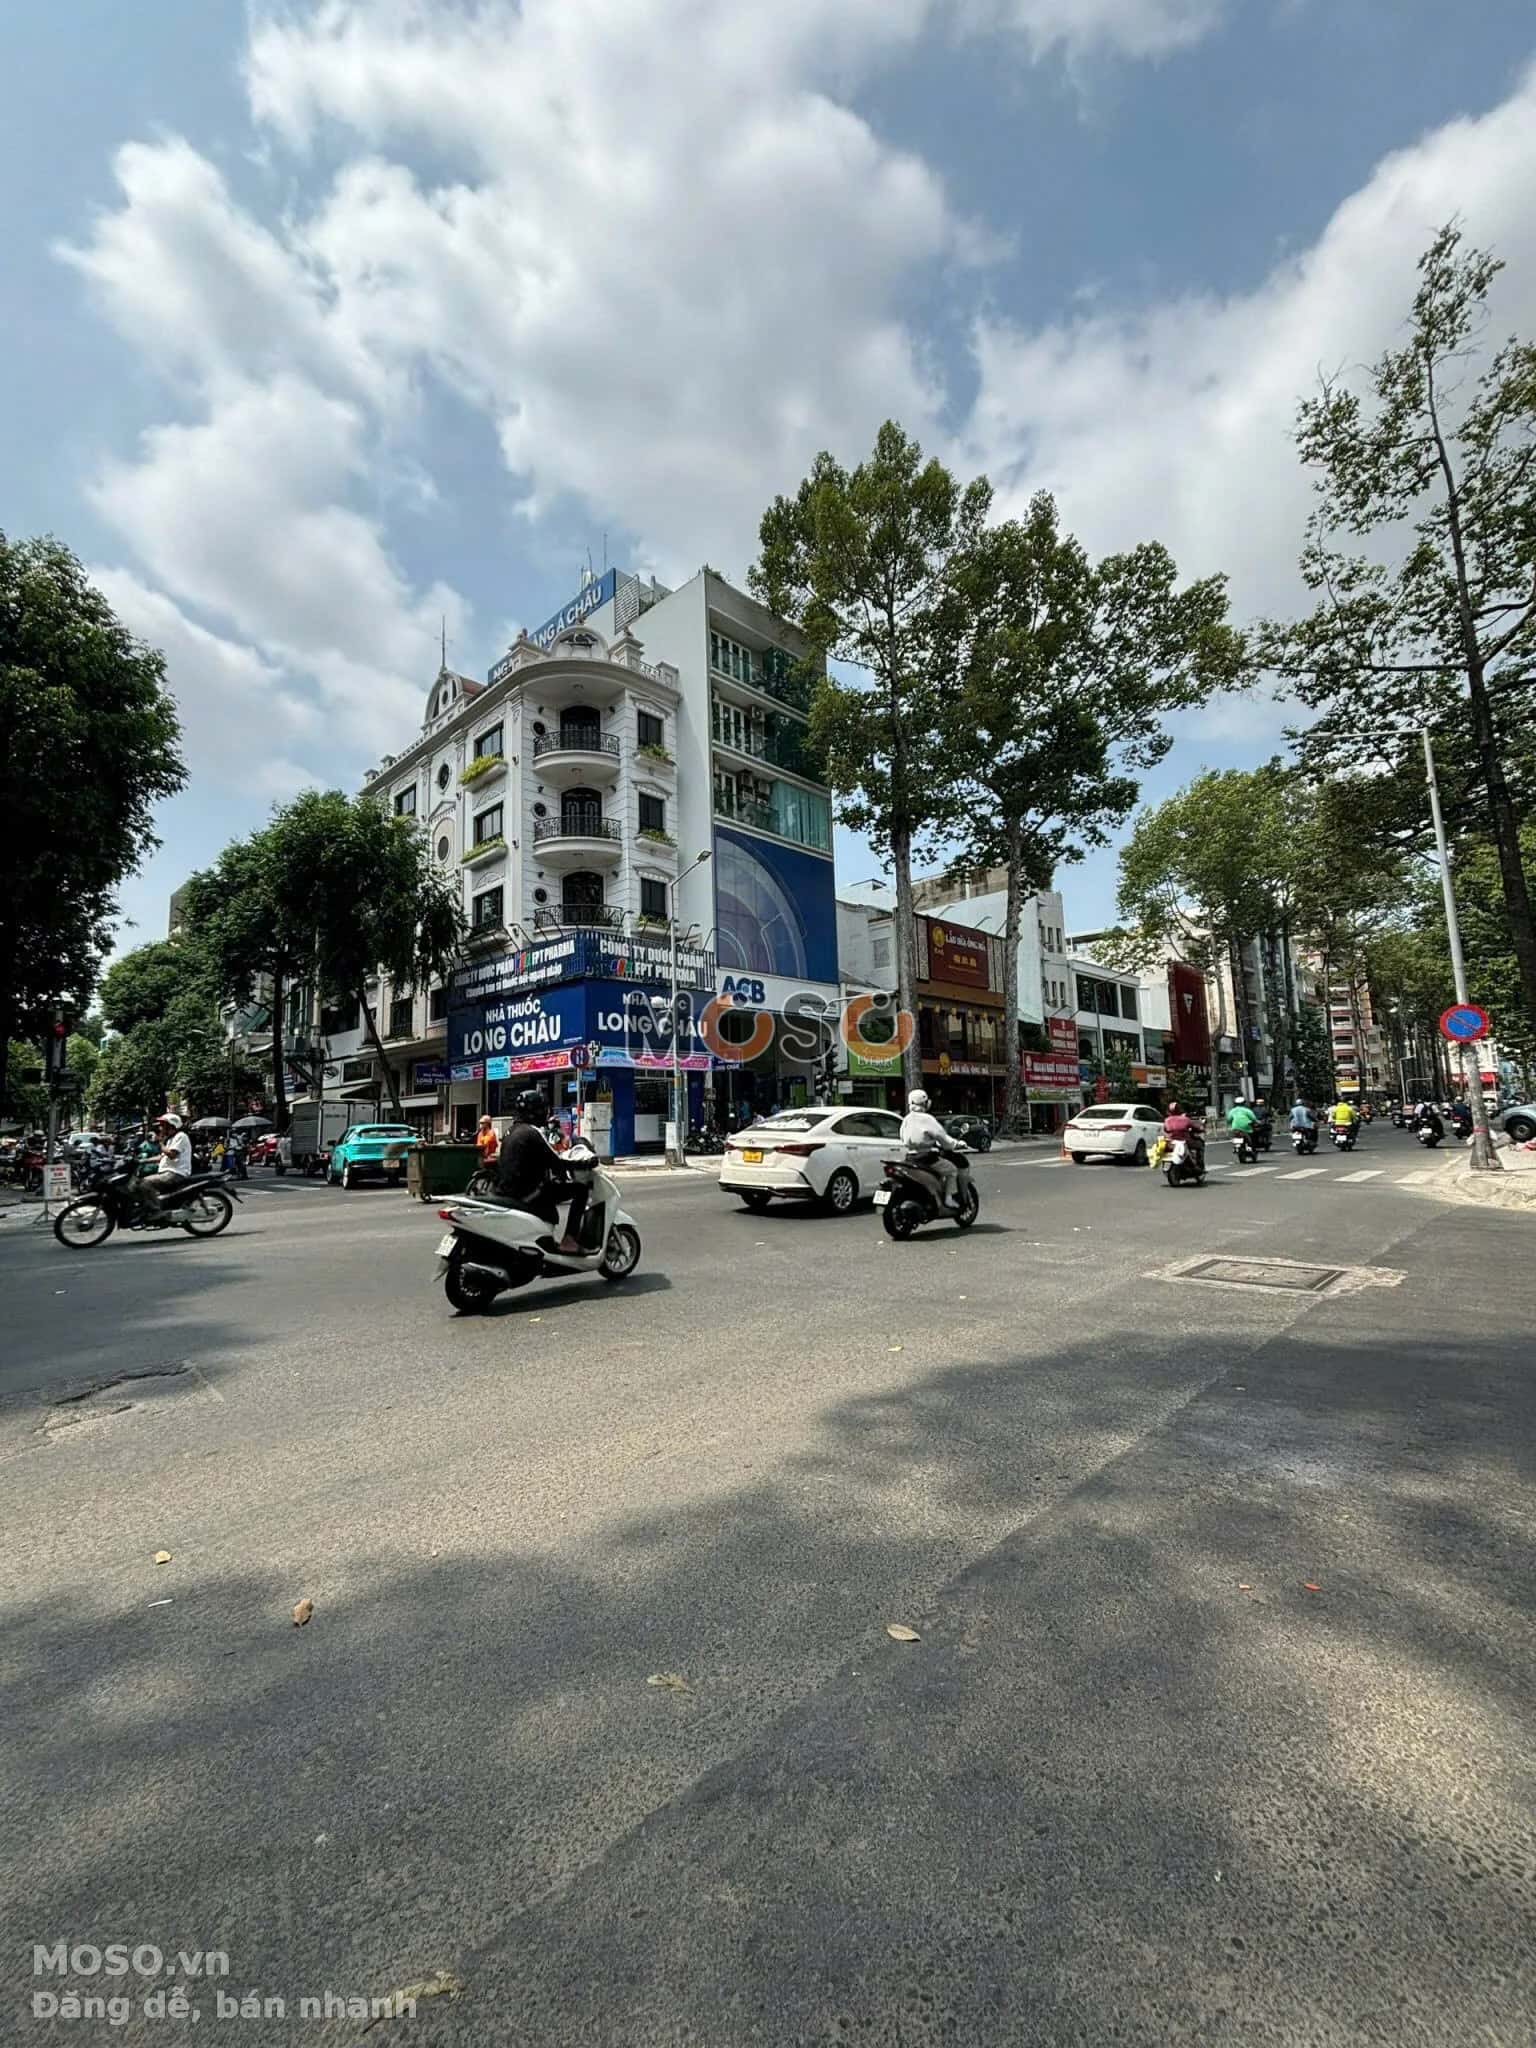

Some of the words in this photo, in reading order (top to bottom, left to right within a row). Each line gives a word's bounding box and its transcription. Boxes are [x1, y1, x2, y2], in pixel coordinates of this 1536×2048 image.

[566, 584, 602, 624] CHÂU
[532, 949, 543, 966] FPT
[632, 945, 645, 960] TY
[634, 961, 653, 977] FPT
[655, 964, 697, 983] PHARMA
[722, 975, 766, 1004] ACB
[486, 1002, 505, 1024] NHÀ
[507, 993, 541, 1019] THUỐC
[464, 1026, 506, 1055] LONG
[510, 1011, 561, 1047] CHÂU
[598, 1012, 652, 1034] LONG
